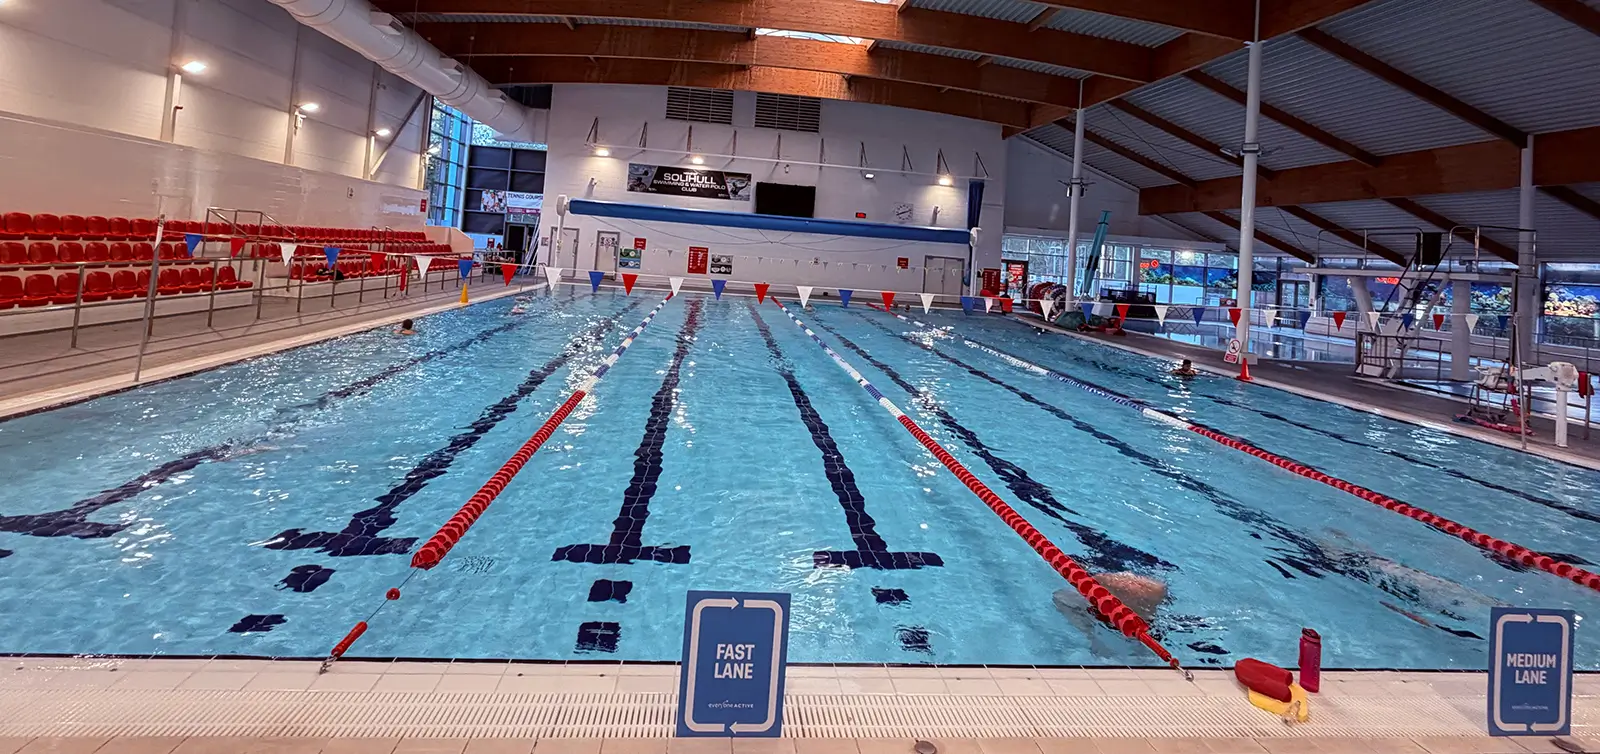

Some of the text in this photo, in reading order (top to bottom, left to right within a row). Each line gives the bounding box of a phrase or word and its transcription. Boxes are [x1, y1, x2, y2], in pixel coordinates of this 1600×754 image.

[653, 179, 685, 187] SWIMMING
[663, 173, 717, 185] SOLIHULL
[507, 192, 525, 200] TENNIS
[716, 643, 755, 661] FAST
[1506, 653, 1557, 668] MEDIUM
[714, 662, 754, 679] LANE
[1515, 670, 1548, 685] LANE
